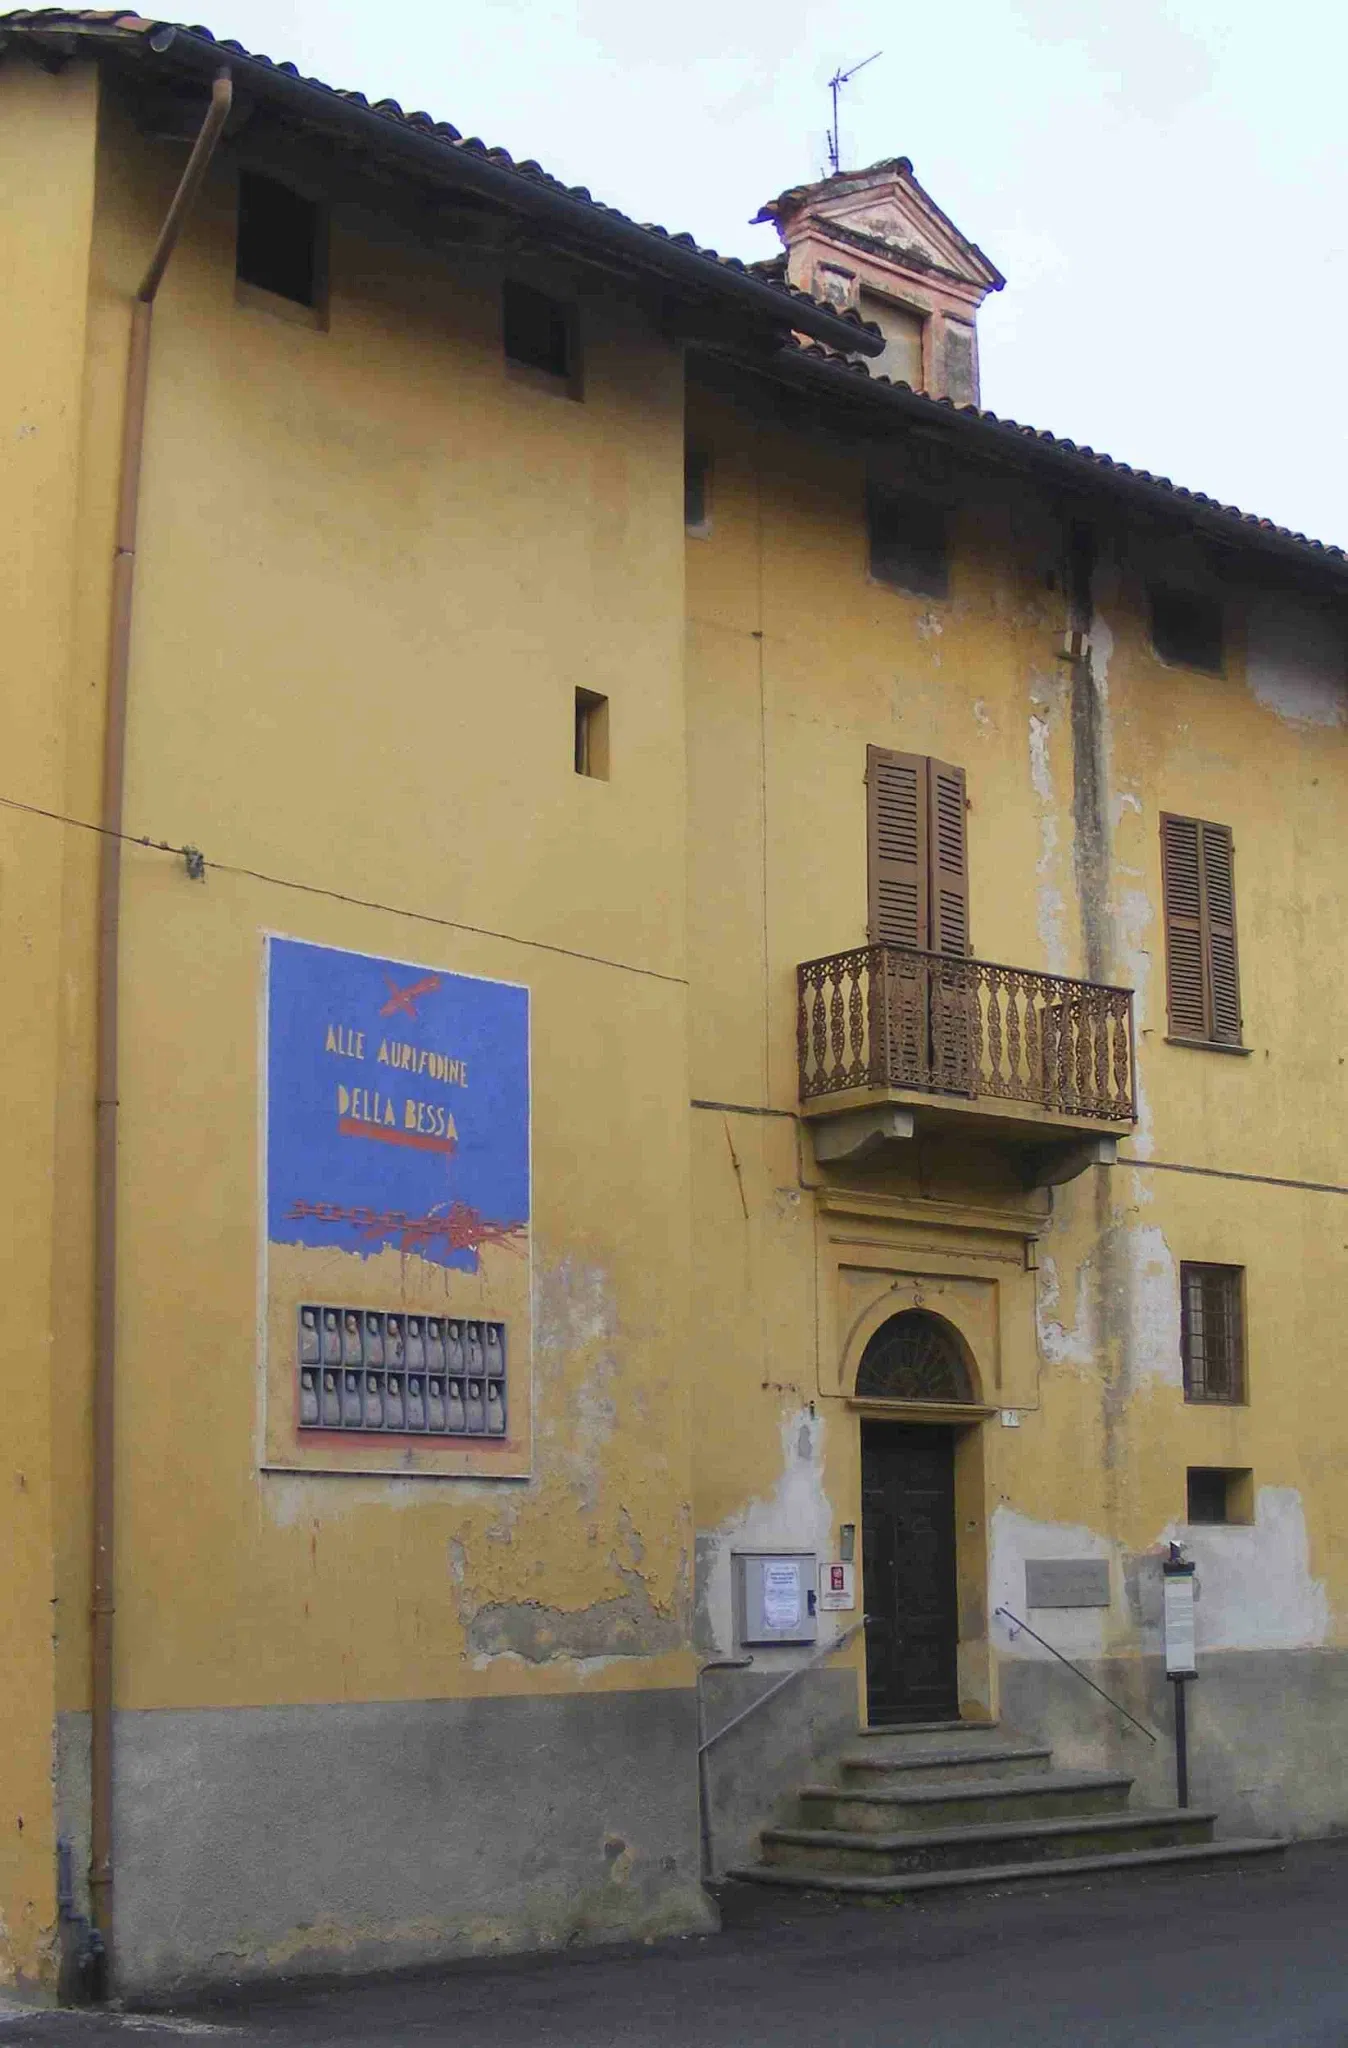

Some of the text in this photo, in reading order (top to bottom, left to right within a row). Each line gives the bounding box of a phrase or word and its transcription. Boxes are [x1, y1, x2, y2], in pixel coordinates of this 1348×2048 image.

[326, 1024, 469, 1088] ALLE AURIFODINE
[339, 1085, 458, 1140] DELLA BESSA
